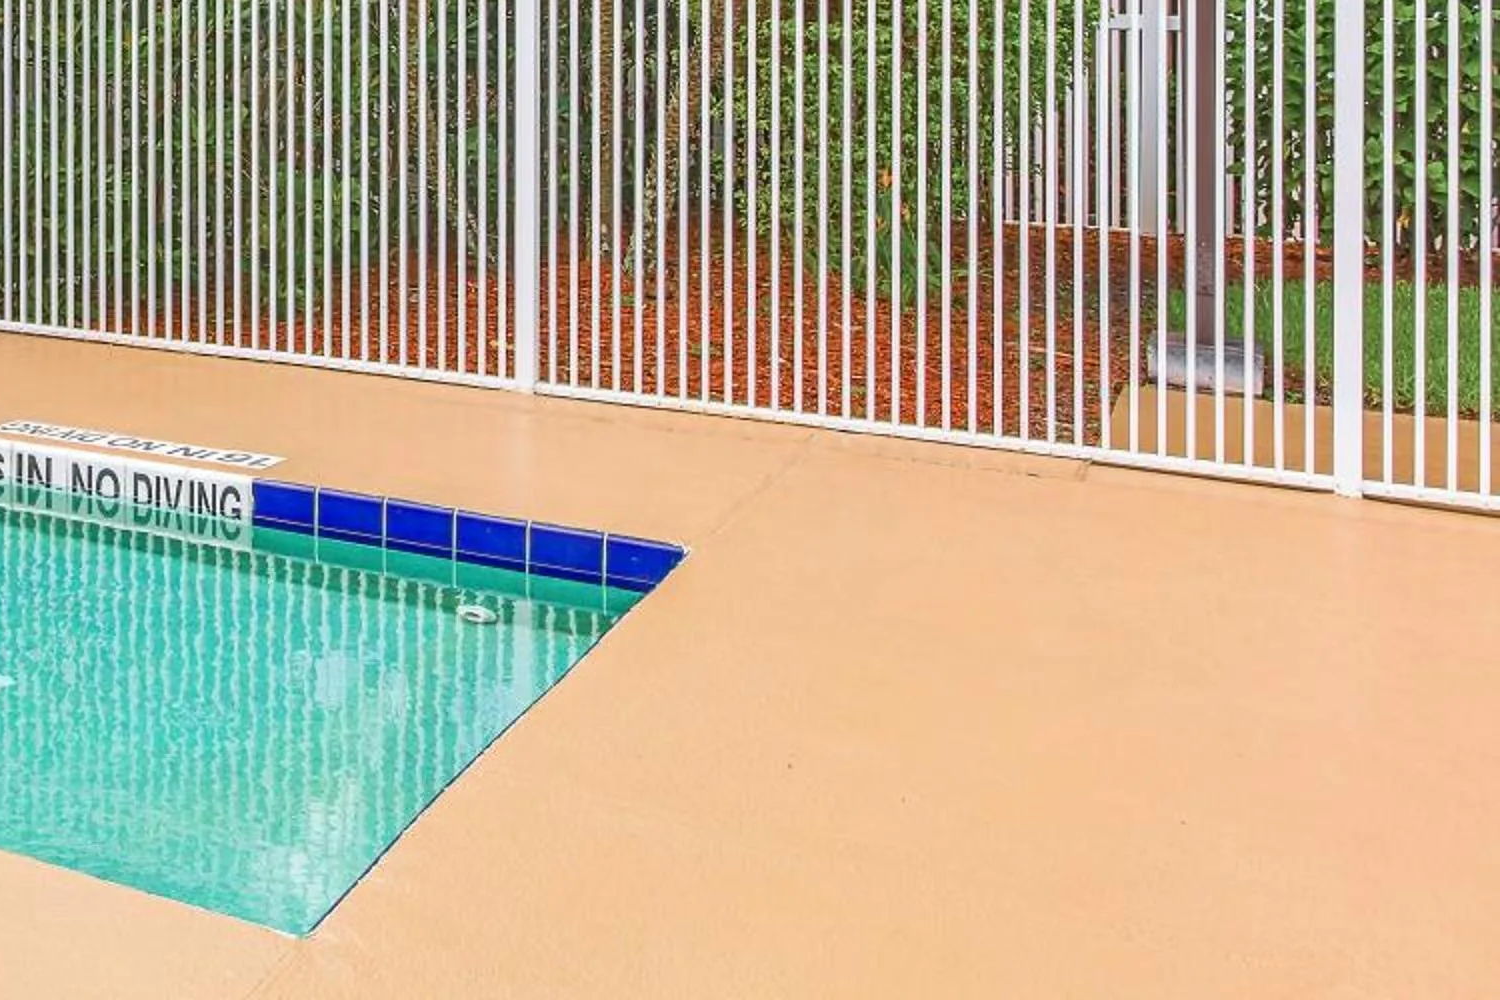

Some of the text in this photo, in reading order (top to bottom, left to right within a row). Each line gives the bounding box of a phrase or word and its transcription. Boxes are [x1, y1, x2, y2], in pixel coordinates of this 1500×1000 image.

[107, 436, 166, 452] NO
[219, 453, 271, 468] 16
[71, 462, 120, 503] NO
[133, 472, 241, 521] DIVING
